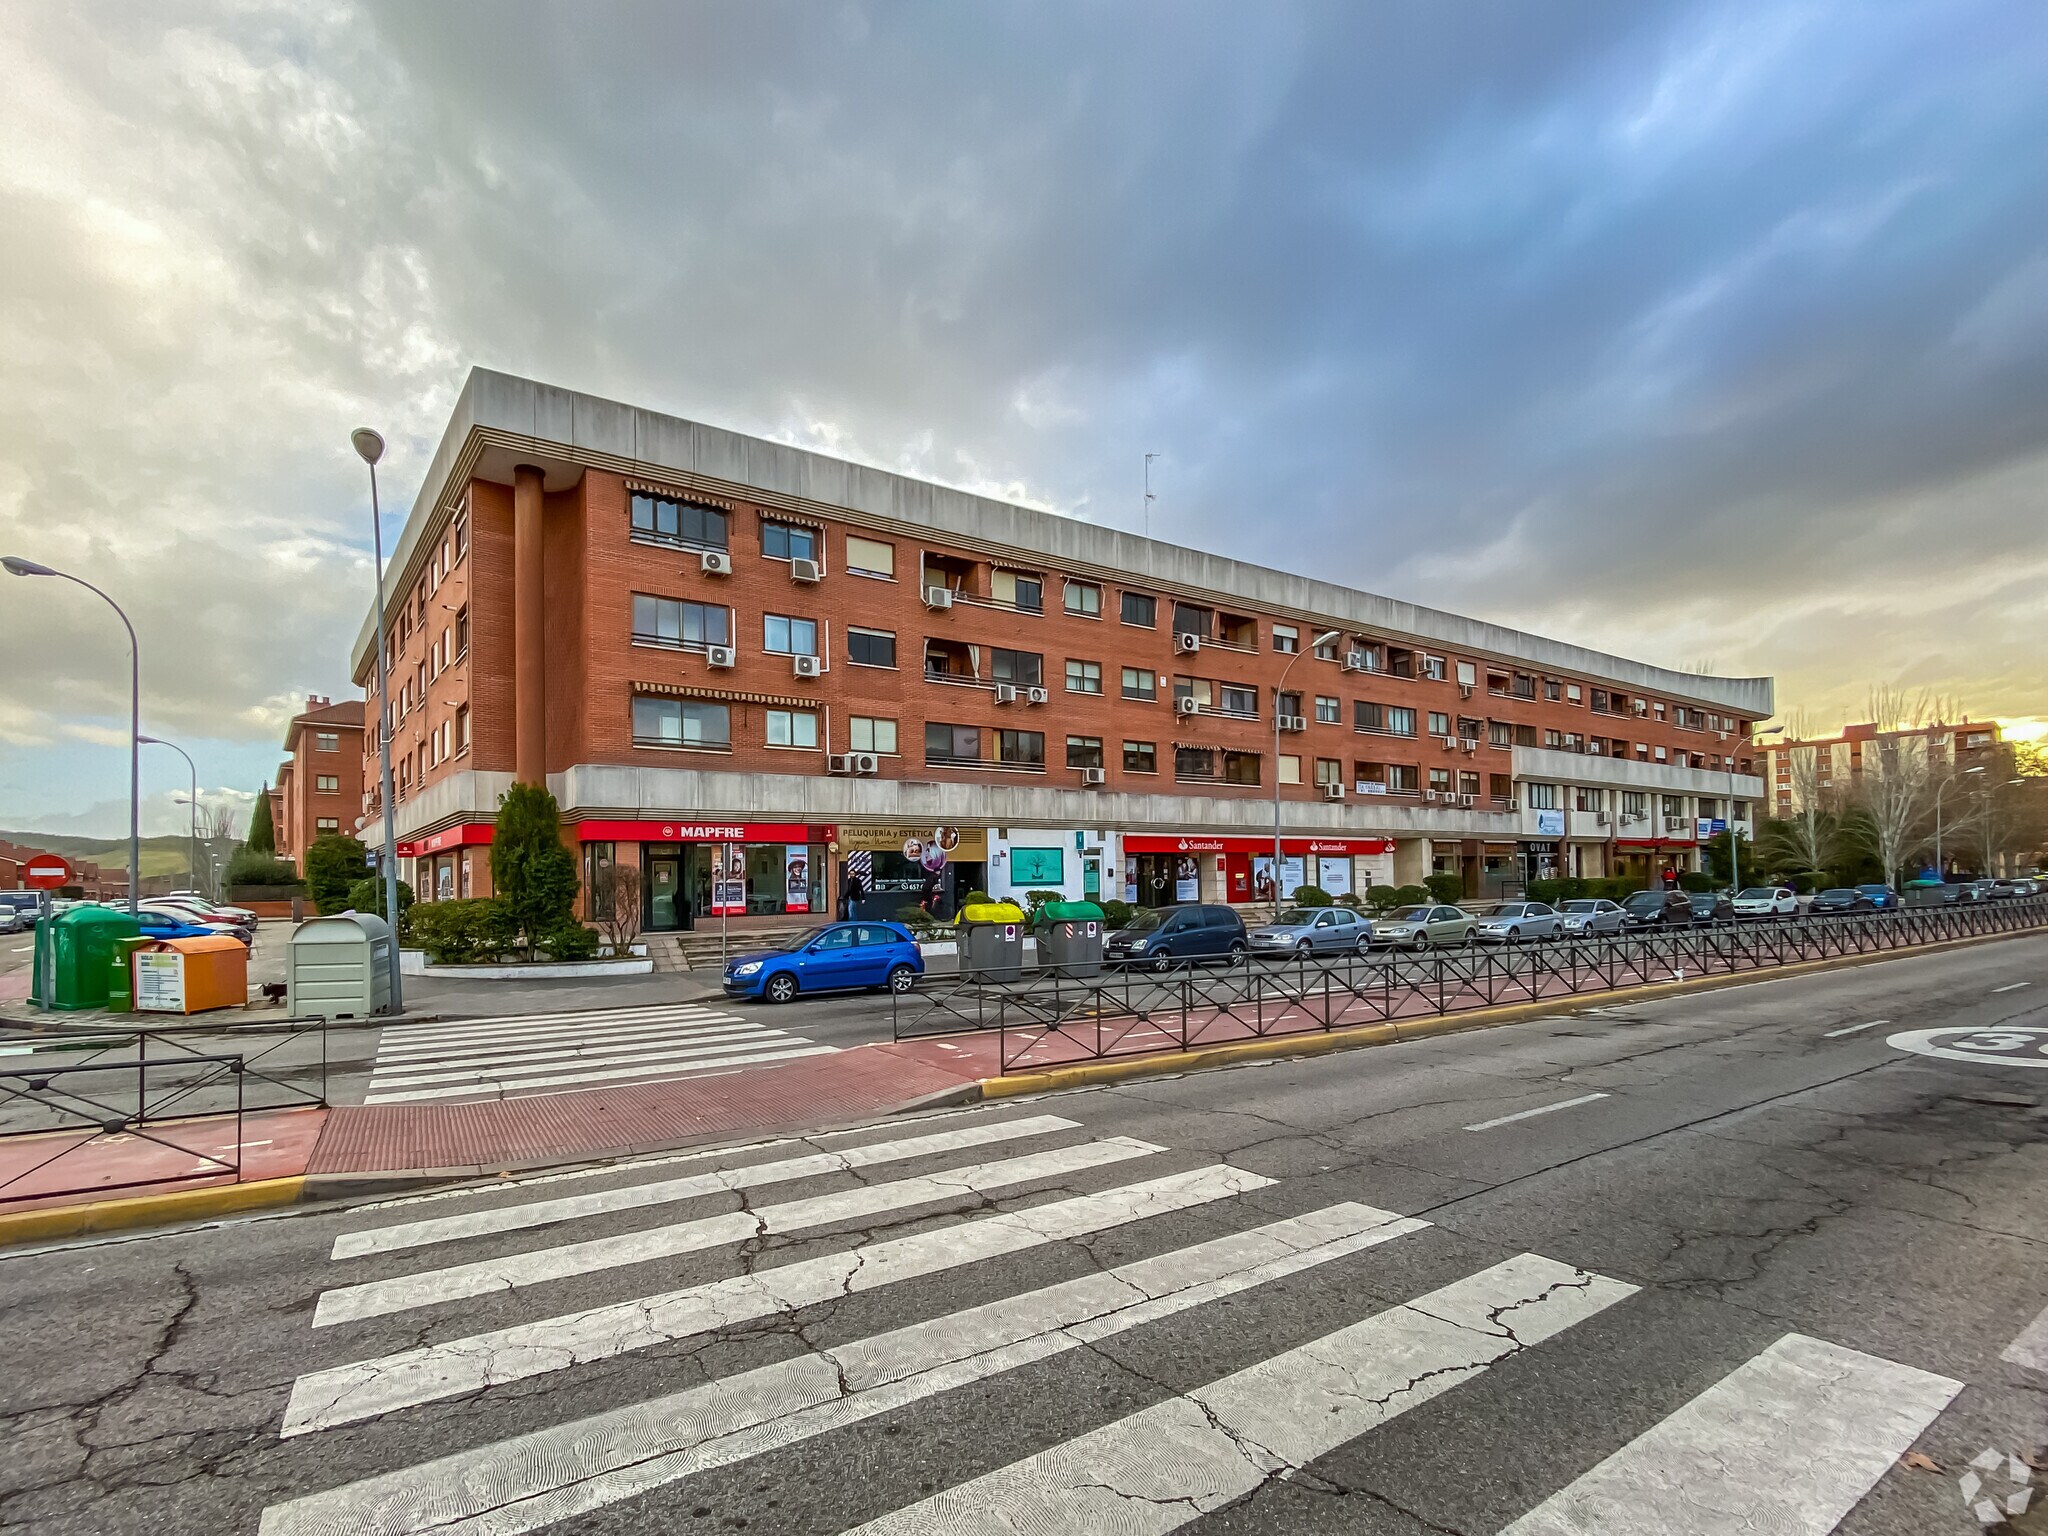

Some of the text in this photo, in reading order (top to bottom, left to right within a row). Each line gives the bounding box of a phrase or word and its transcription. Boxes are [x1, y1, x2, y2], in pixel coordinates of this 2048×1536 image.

[680, 826, 745, 838] MAPFRE
[843, 828, 933, 839] PELUQUERÍA y ESTÉTICA
[1188, 840, 1224, 850] Santander
[1318, 841, 1347, 851] Santander
[1951, 1032, 2048, 1055] 3
